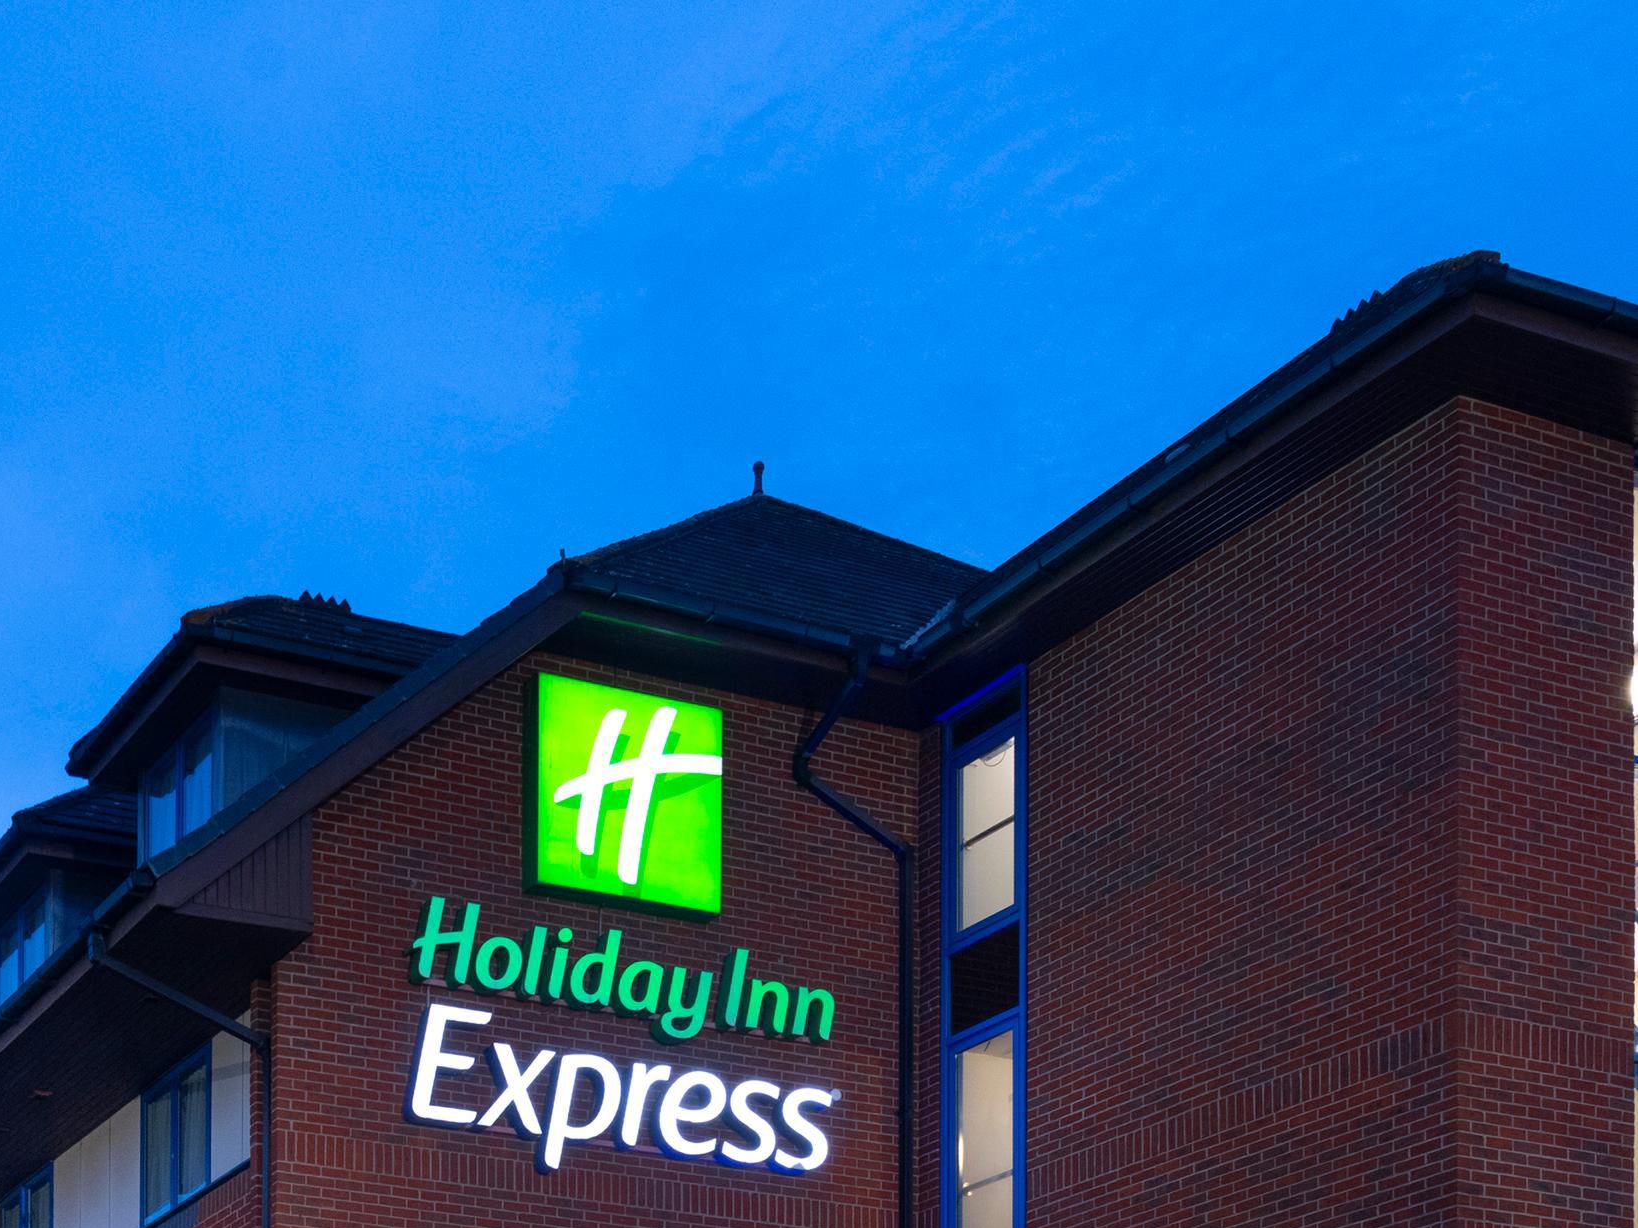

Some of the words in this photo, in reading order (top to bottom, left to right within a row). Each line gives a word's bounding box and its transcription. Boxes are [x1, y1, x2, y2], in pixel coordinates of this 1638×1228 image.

[412, 895, 714, 1039] Holiday
[726, 948, 836, 1041] Inn
[411, 1003, 834, 1170] Express
